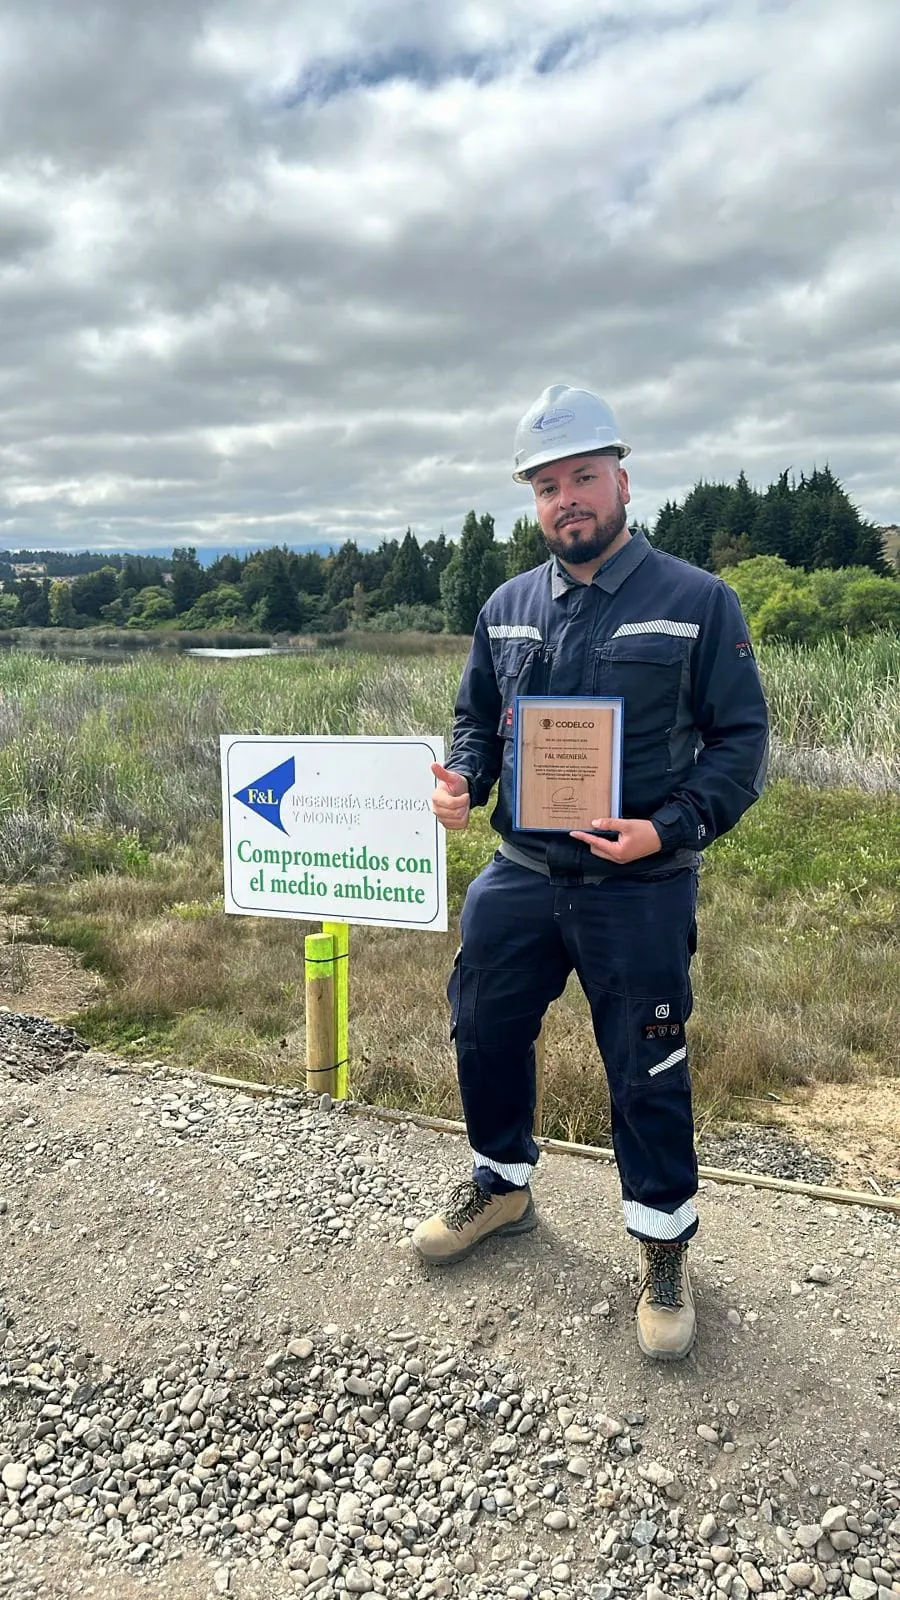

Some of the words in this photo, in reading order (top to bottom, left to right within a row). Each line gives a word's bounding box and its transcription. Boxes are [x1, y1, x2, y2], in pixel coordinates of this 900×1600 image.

[555, 721, 595, 729] CODELCO
[247, 788, 279, 805] F&L
[292, 793, 361, 810] INGENIERÍA
[364, 794, 431, 812] ELÉCTRICA
[293, 811, 301, 824] Y
[303, 811, 361, 826] MONTAJE
[237, 840, 390, 873] Comprometidos
[395, 857, 433, 874] con
[250, 869, 264, 893] el
[270, 871, 328, 897] medio
[333, 876, 425, 904] ambiente
